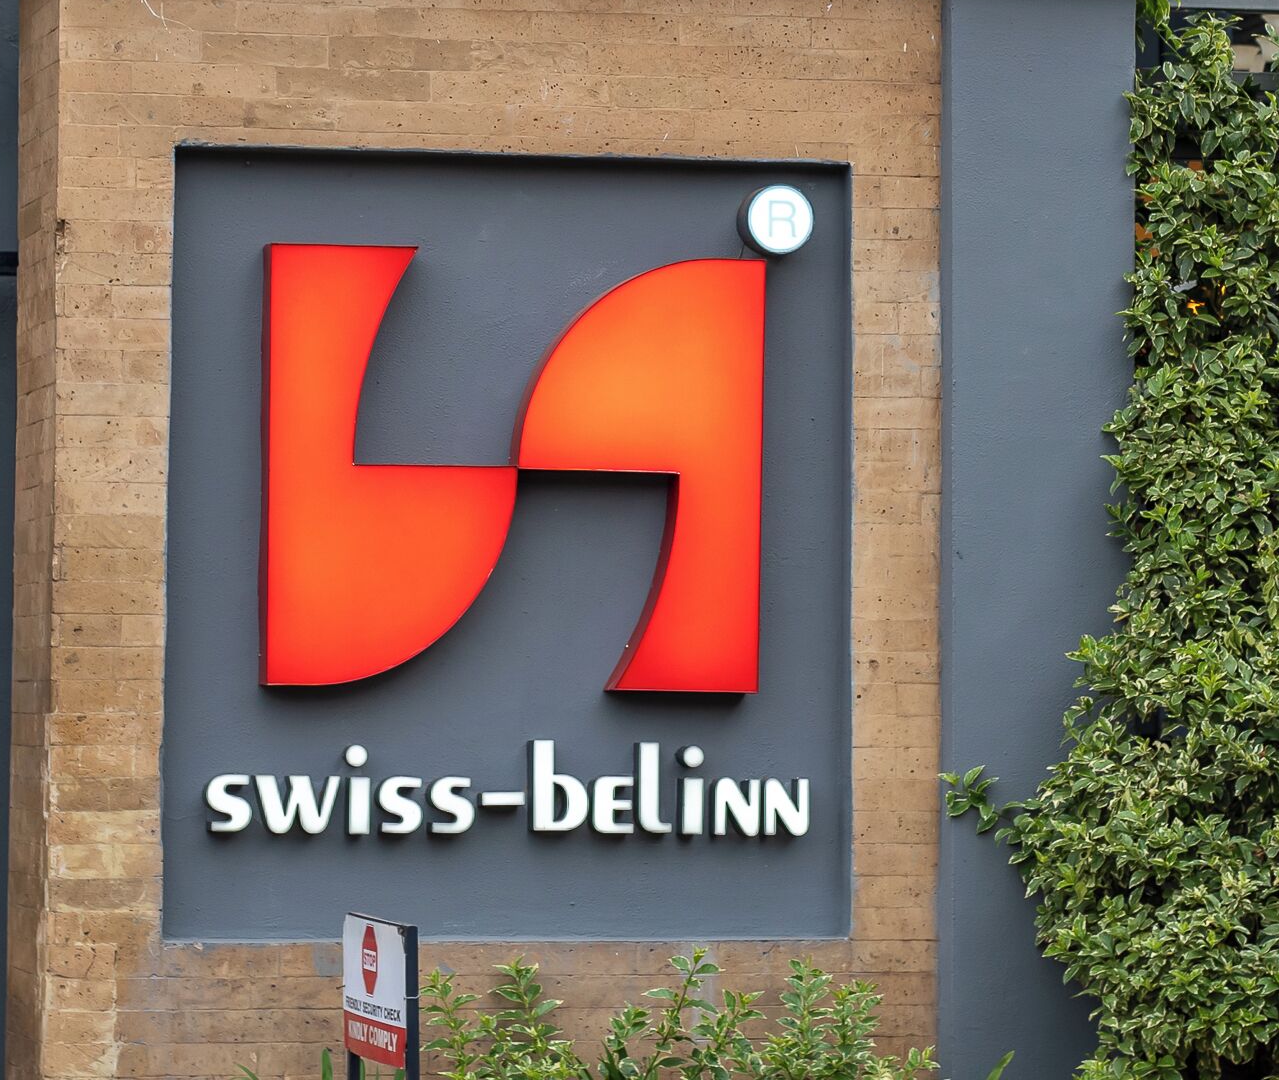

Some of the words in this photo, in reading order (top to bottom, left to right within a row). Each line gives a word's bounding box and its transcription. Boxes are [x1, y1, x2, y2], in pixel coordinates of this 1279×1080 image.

[363, 951, 376, 968] STOP
[345, 995, 362, 1012] FRIENDLY
[362, 1001, 383, 1018] SECURITY
[384, 1007, 401, 1022] CHECK
[348, 1019, 368, 1042] KINDLY
[368, 1025, 398, 1053] COMPLY
